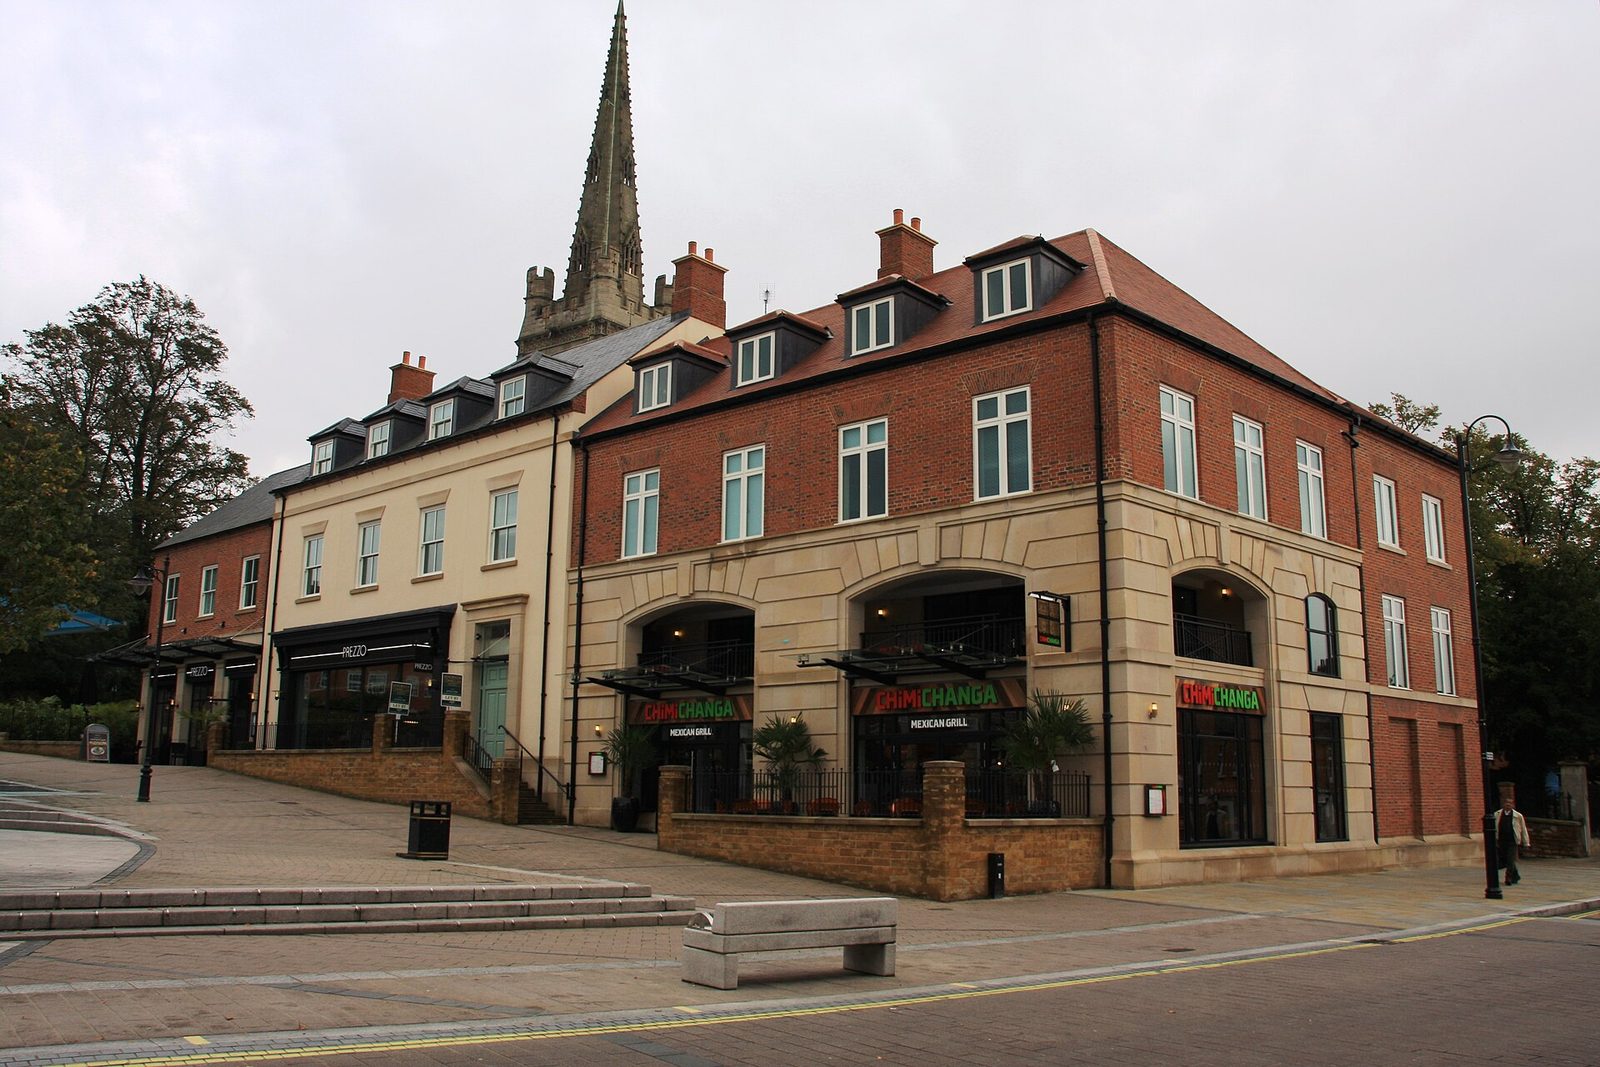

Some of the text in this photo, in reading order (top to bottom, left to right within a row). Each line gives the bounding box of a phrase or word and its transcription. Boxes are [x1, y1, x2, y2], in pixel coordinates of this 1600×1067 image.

[342, 644, 367, 658] PREZZO
[190, 665, 208, 677] PREZZO
[910, 717, 968, 729] MEXICAN GRILL
[670, 727, 712, 737] MEXICAN GRILL
